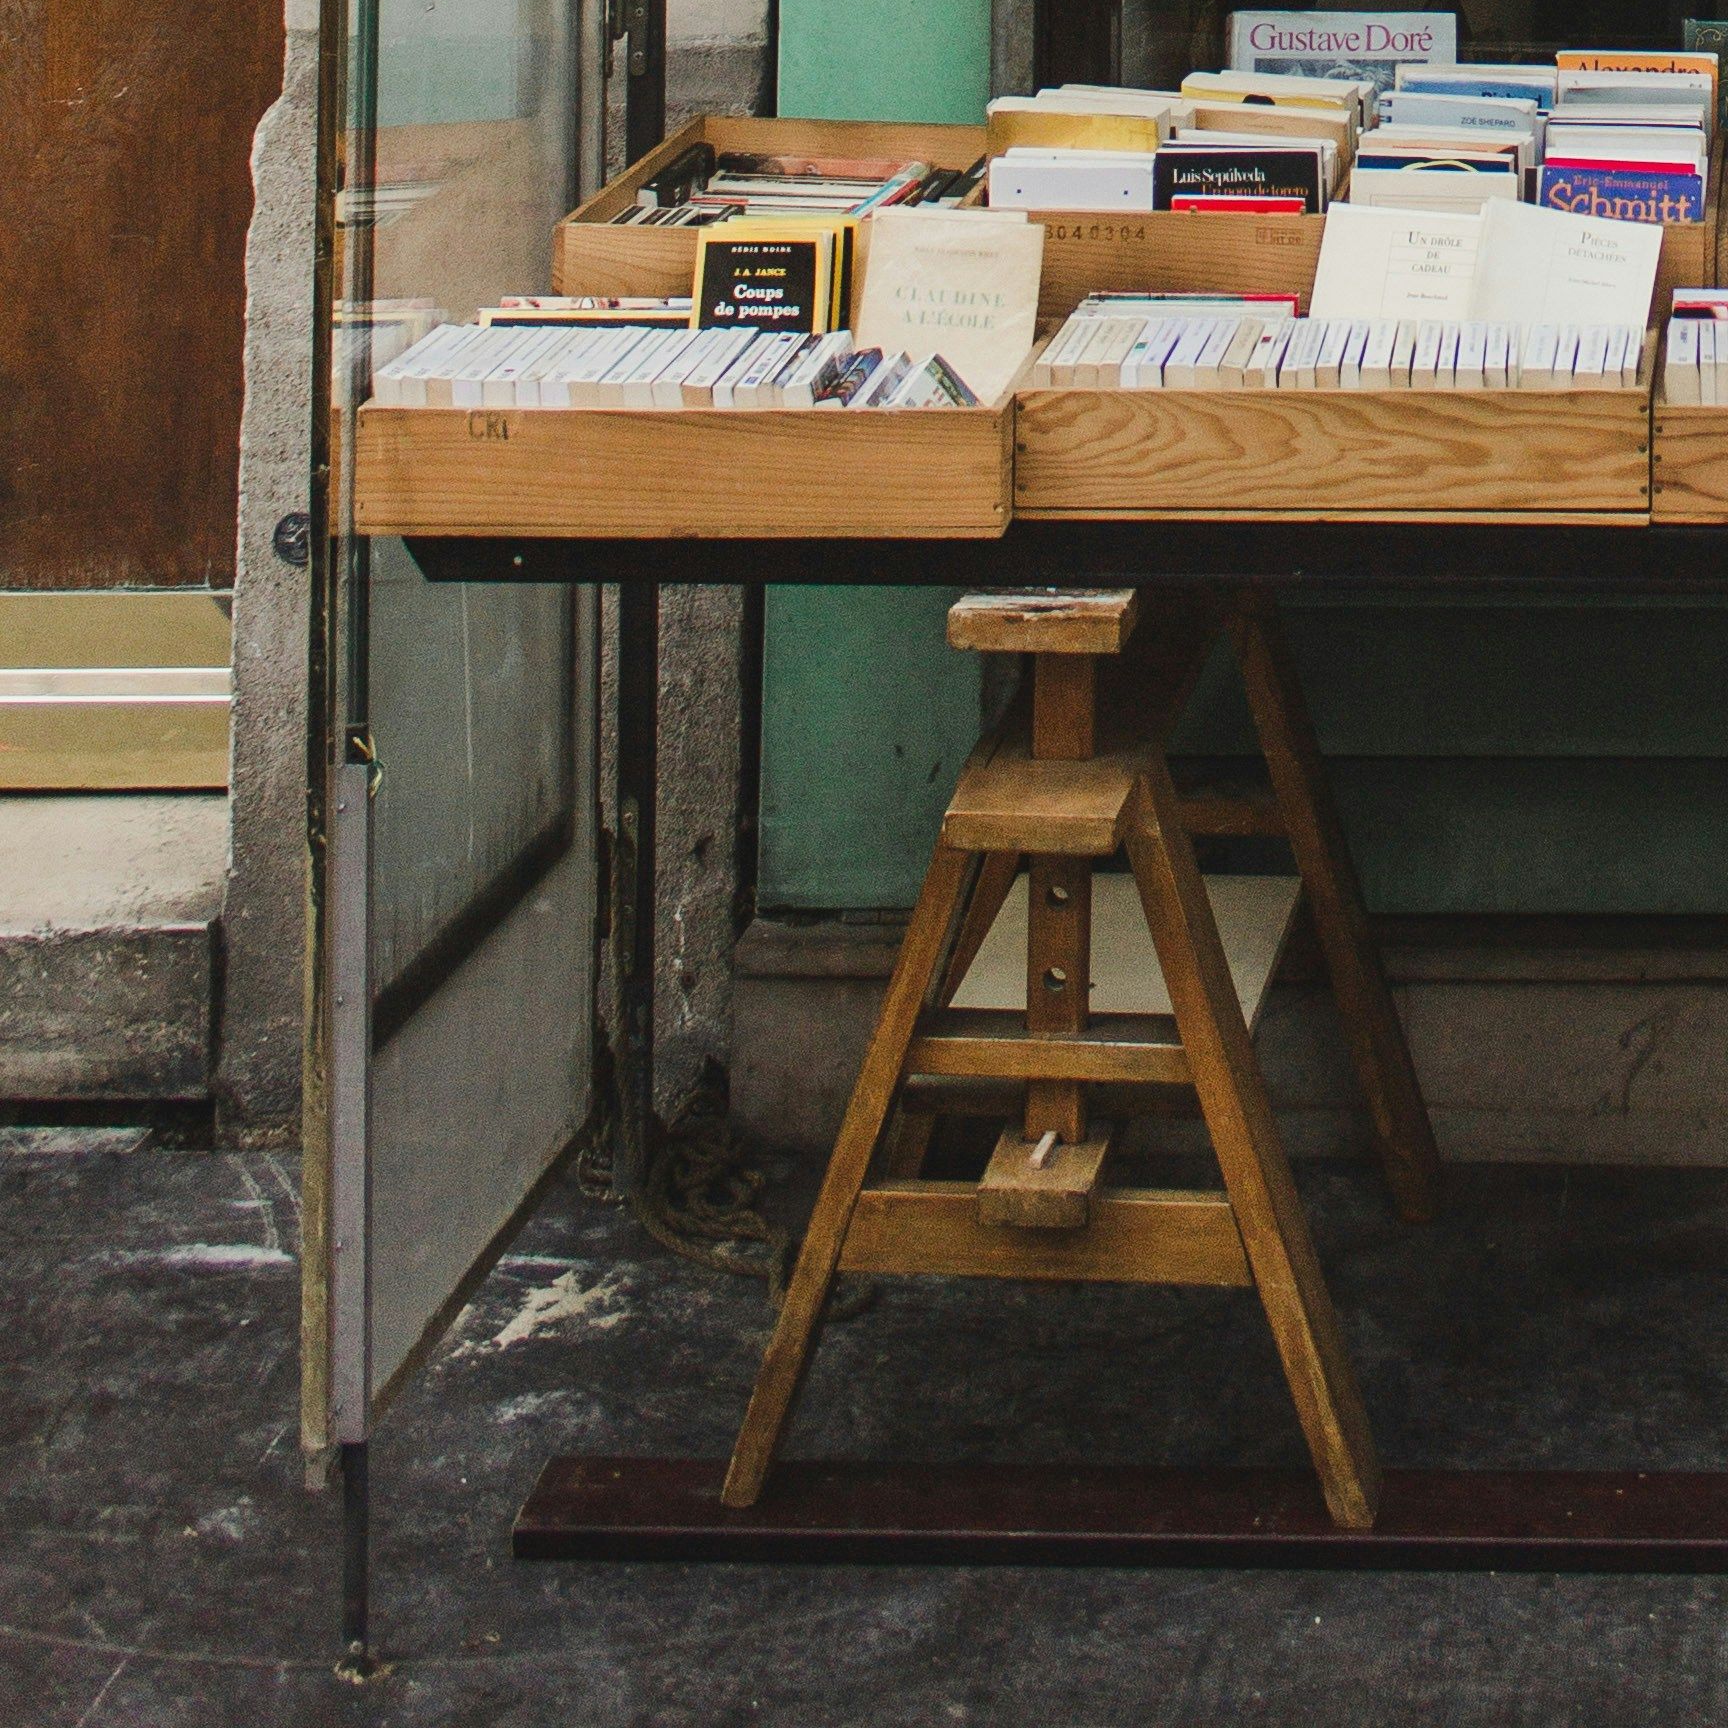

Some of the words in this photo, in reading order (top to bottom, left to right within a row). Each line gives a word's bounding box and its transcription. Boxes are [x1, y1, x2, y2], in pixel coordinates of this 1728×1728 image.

[1249, 22, 1360, 52] Gustave
[1364, 24, 1434, 52] Doré
[1479, 118, 1516, 128] SHEPARD
[1173, 168, 1201, 183] Luis
[1201, 166, 1266, 187] Sepúlveda
[1573, 174, 1669, 190] Eric-Emmanuel
[1549, 181, 1692, 225] Schmitt
[1429, 236, 1463, 249] DRÔLE
[1426, 250, 1440, 260] DE
[1411, 263, 1451, 274] CADEAU
[734, 284, 784, 300] Coups
[896, 287, 1005, 308] CLAUDINE
[714, 302, 735, 317] de
[738, 304, 800, 320] pompes
